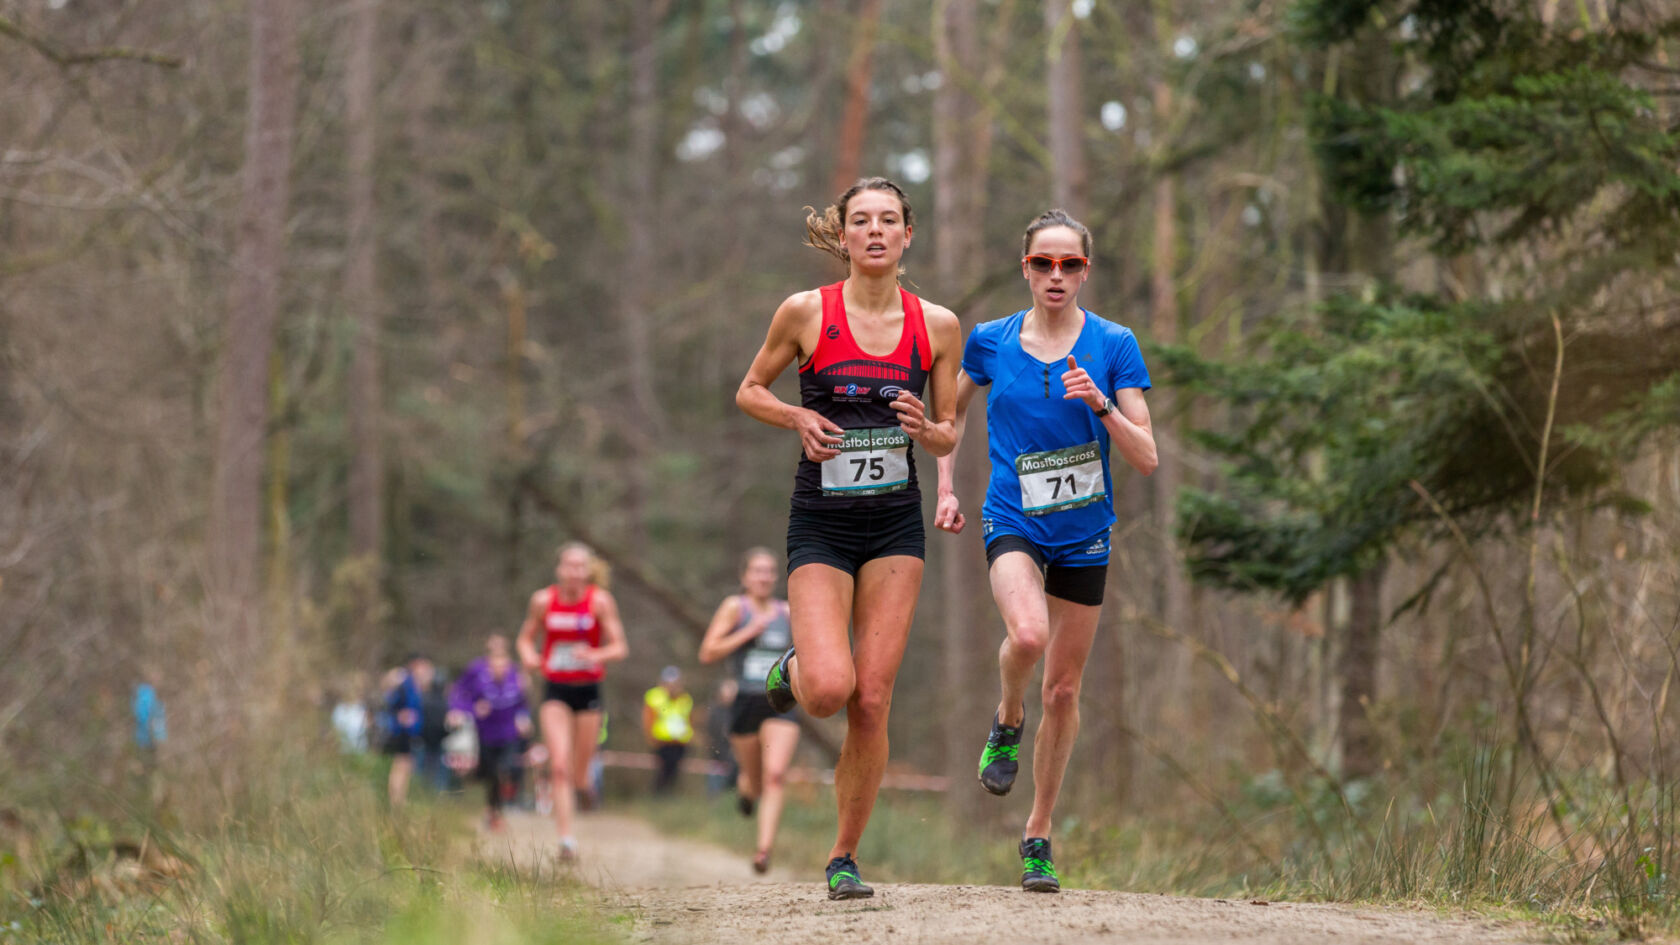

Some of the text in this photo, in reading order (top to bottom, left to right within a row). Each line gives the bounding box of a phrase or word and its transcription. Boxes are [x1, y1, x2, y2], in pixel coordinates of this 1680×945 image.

[850, 457, 884, 482] 75
[1022, 449, 1095, 471] Mastboscross
[1046, 473, 1077, 499] 71
